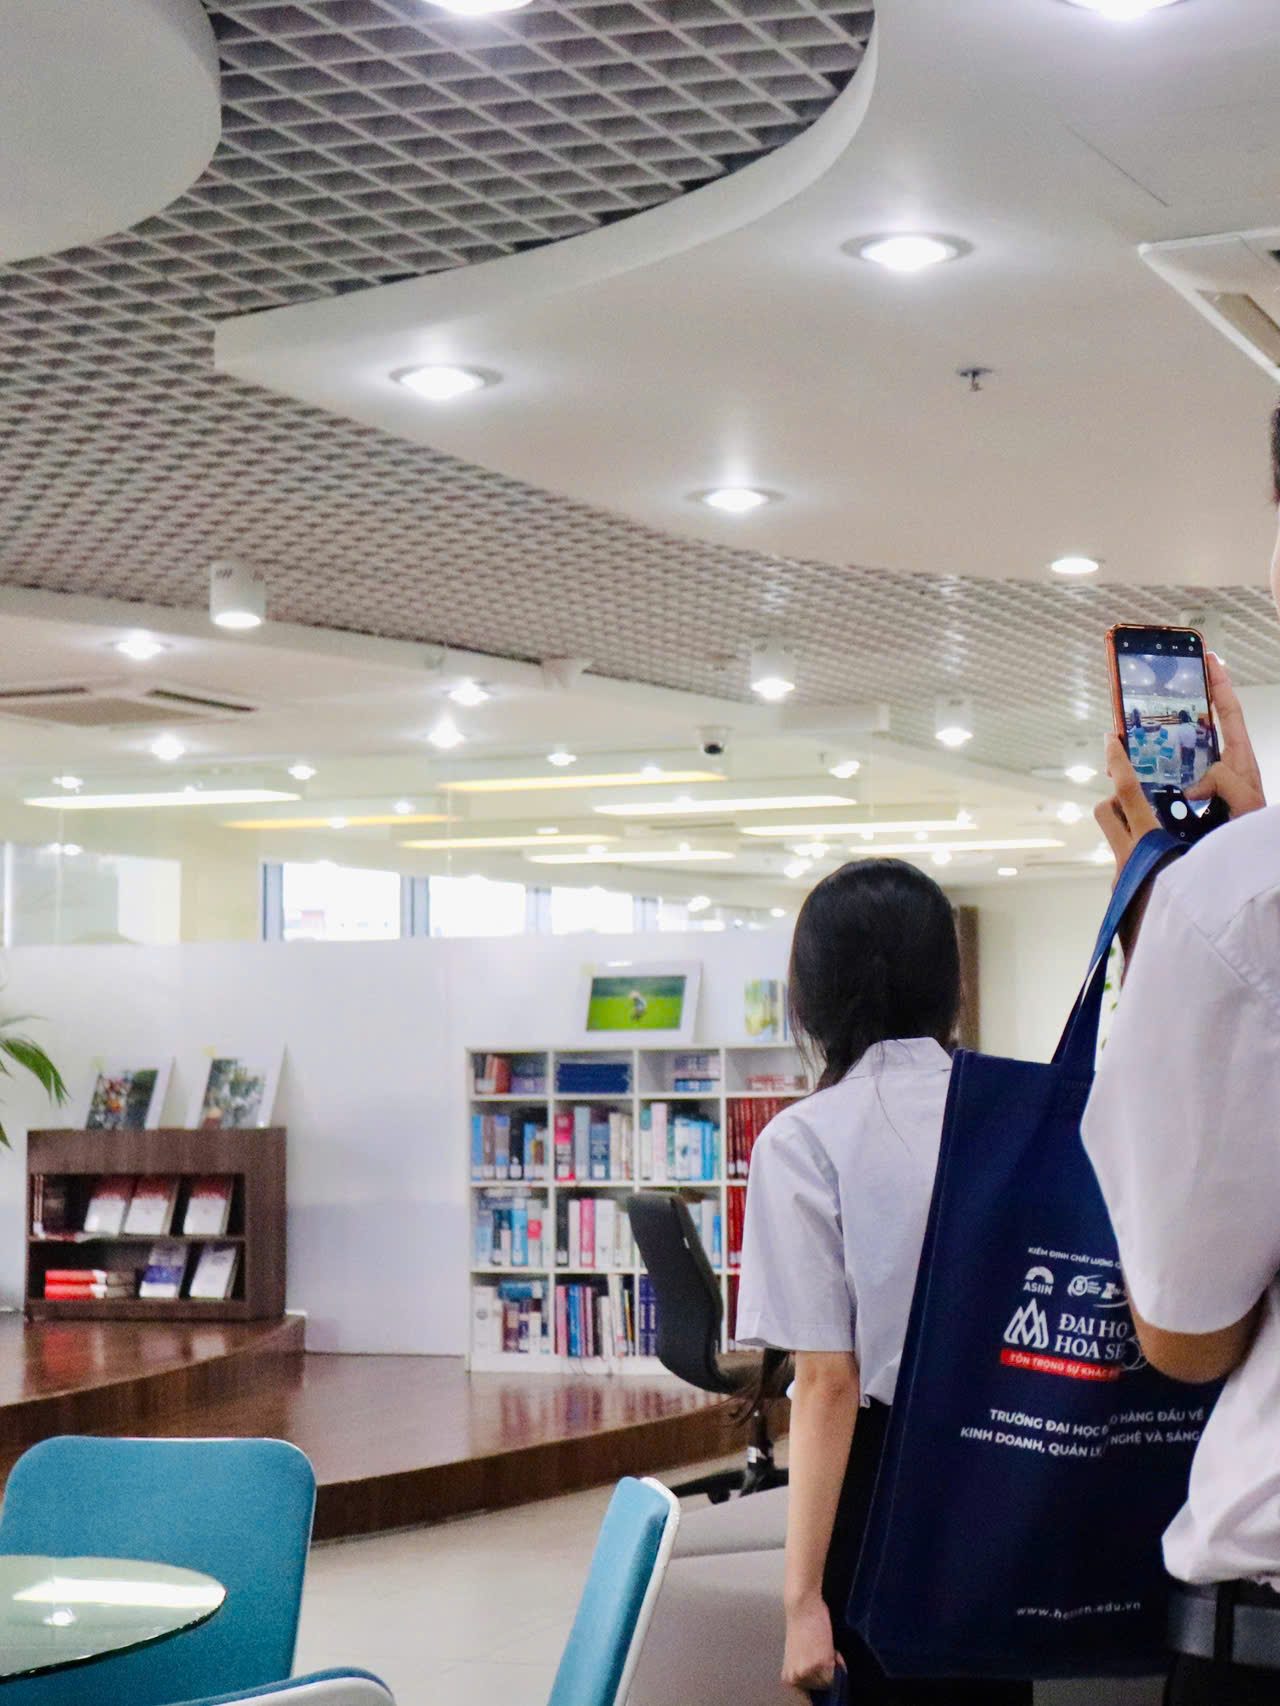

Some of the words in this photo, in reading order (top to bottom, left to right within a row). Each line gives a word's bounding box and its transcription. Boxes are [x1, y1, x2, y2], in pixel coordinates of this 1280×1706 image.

[1023, 1282, 1053, 1296] ASIIN
[1058, 1313, 1095, 1336] ĐẠI
[1054, 1334, 1100, 1359] HOA
[990, 1409, 1043, 1429] TRƯỜNG
[1045, 1419, 1070, 1435] ĐẠI
[1073, 1425, 1100, 1438] HỌC
[1120, 1410, 1154, 1424] HÀNG
[960, 1427, 993, 1442] KINH
[995, 1432, 1045, 1453] DOANH,
[1049, 1441, 1088, 1457] QUẢN
